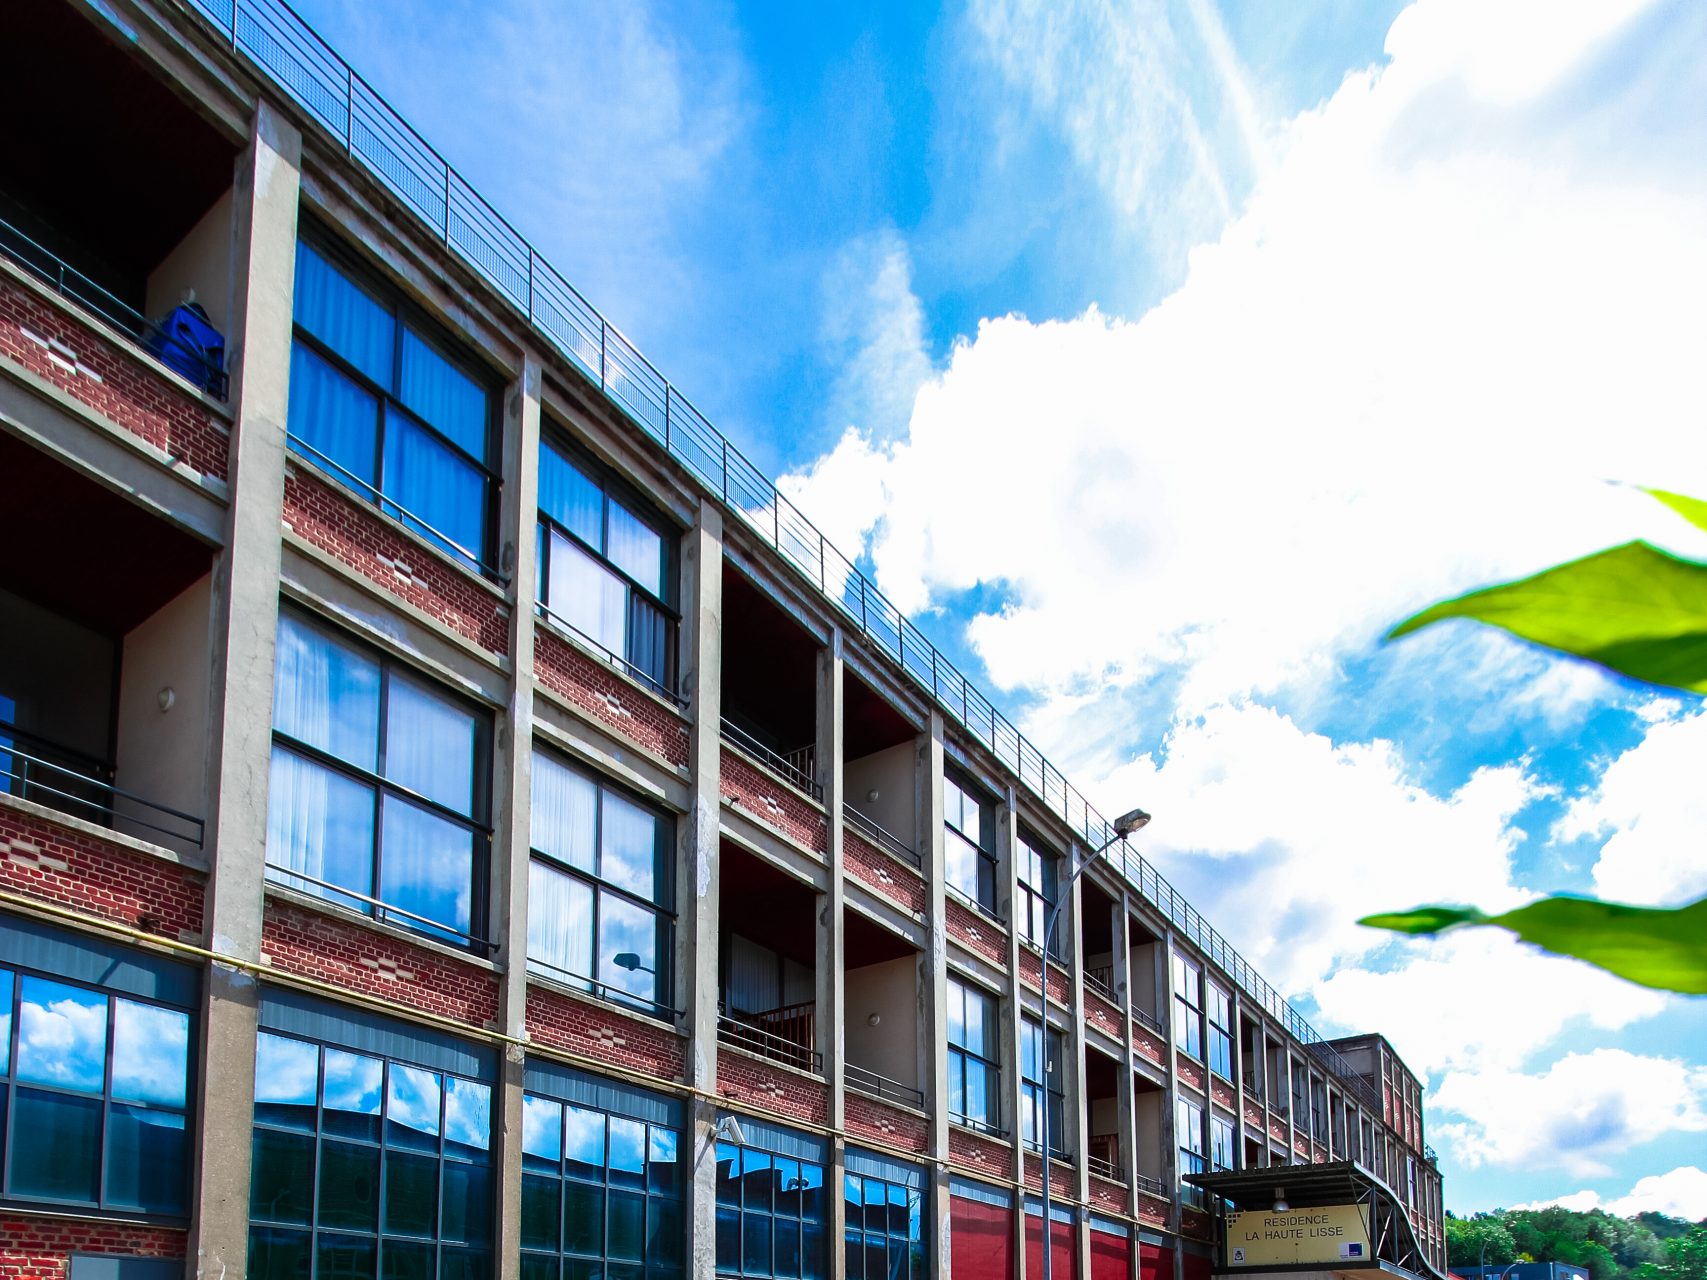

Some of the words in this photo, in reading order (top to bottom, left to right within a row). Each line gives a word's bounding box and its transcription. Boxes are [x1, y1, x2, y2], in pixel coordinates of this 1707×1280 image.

[1264, 1215, 1329, 1227] RESIDENCE
[1245, 1232, 1259, 1241] LA
[1264, 1229, 1304, 1240] HAUTE
[1310, 1226, 1344, 1238] LISSE
